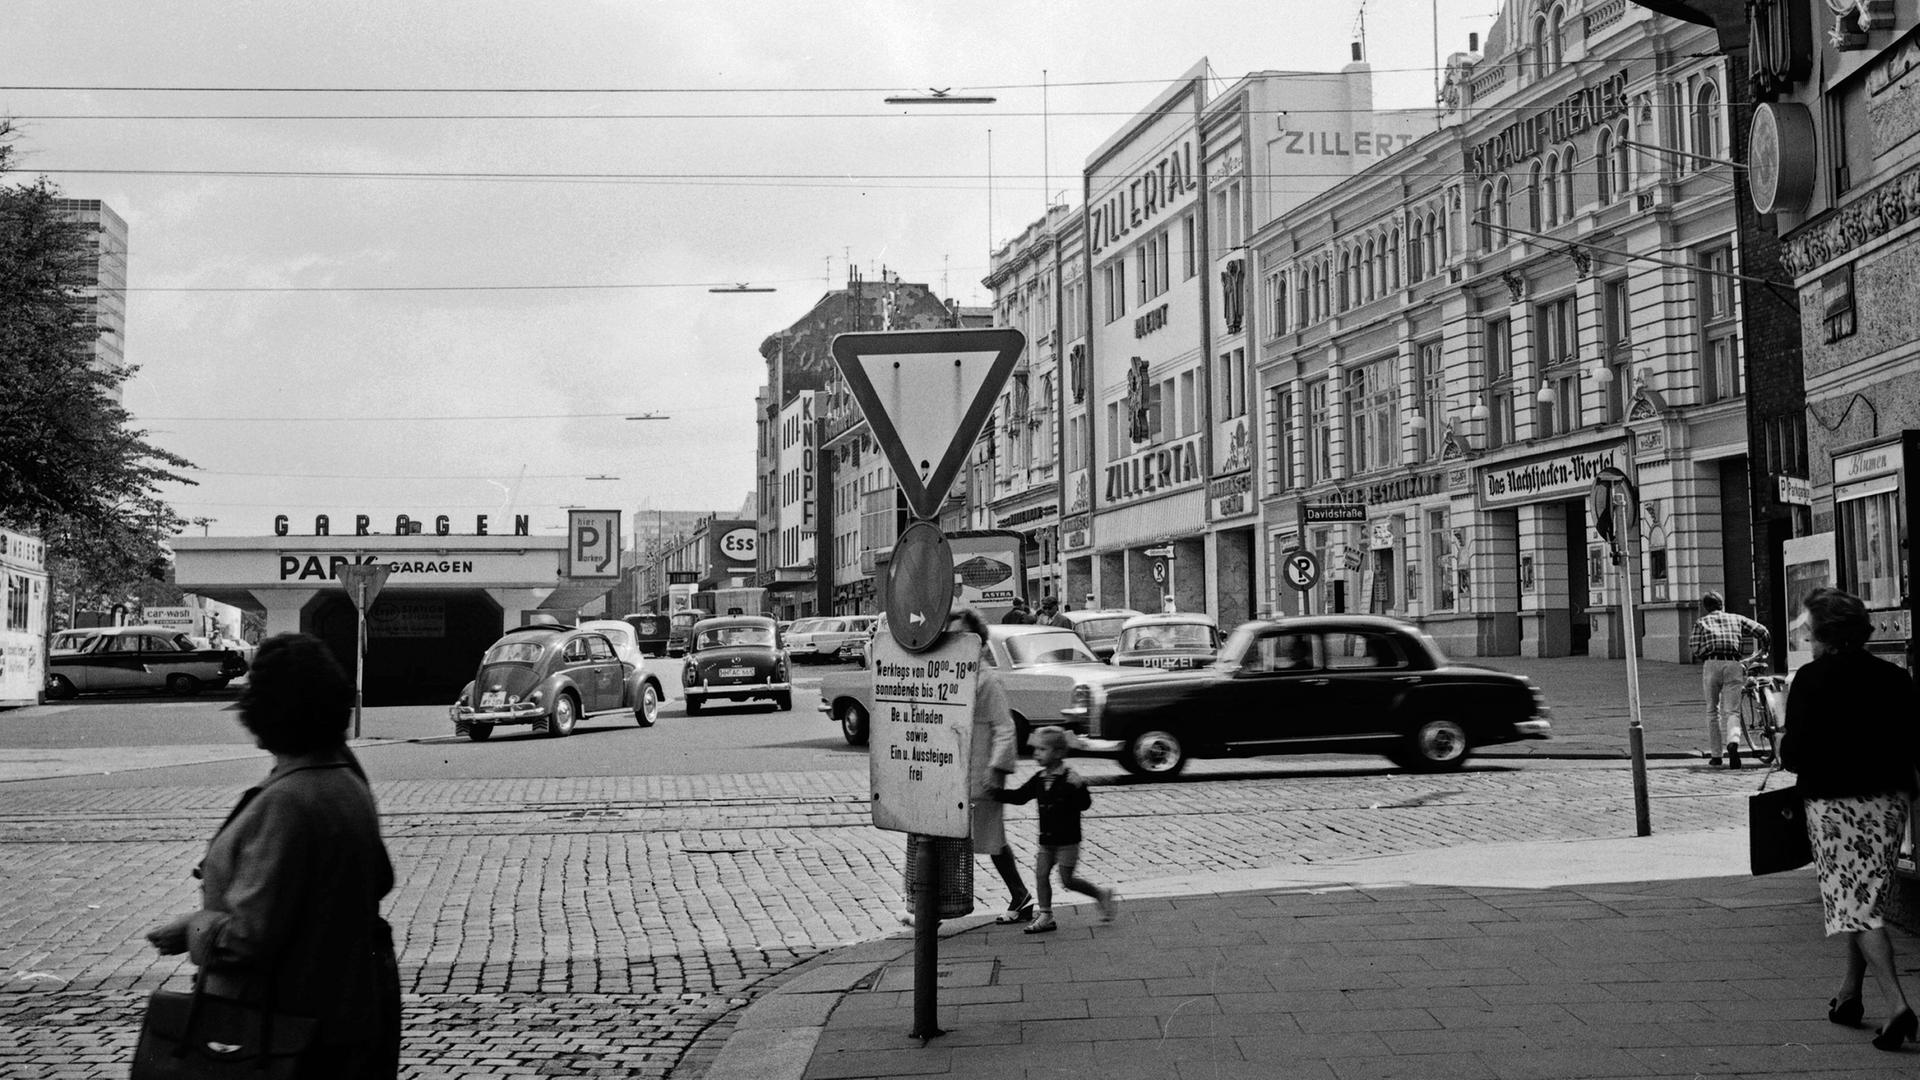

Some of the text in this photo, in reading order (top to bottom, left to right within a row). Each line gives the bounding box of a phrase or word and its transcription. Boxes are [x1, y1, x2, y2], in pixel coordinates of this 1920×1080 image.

[1285, 131, 1412, 156] ZILLERT
[1091, 141, 1197, 256] ZILLERTAL
[803, 397, 813, 525] KNOPF
[1848, 453, 1887, 476] Blumen
[1488, 475, 1505, 496] Das
[1307, 509, 1363, 519] Davidstraße
[274, 514, 529, 536] GARAGEN
[726, 535, 754, 551] Ess
[389, 561, 472, 573] GARAGEN
[147, 610, 190, 618] car-wash
[1143, 657, 1193, 668] POLIZEI
[912, 667, 924, 678] von
[875, 682, 920, 697] sonnabends
[921, 682, 933, 698] bis
[891, 706, 943, 724] Be. u. Entladen
[905, 728, 928, 743] sowie
[890, 744, 902, 761] Ein
[911, 746, 953, 767] Aussteigen
[909, 765, 923, 781] frei
